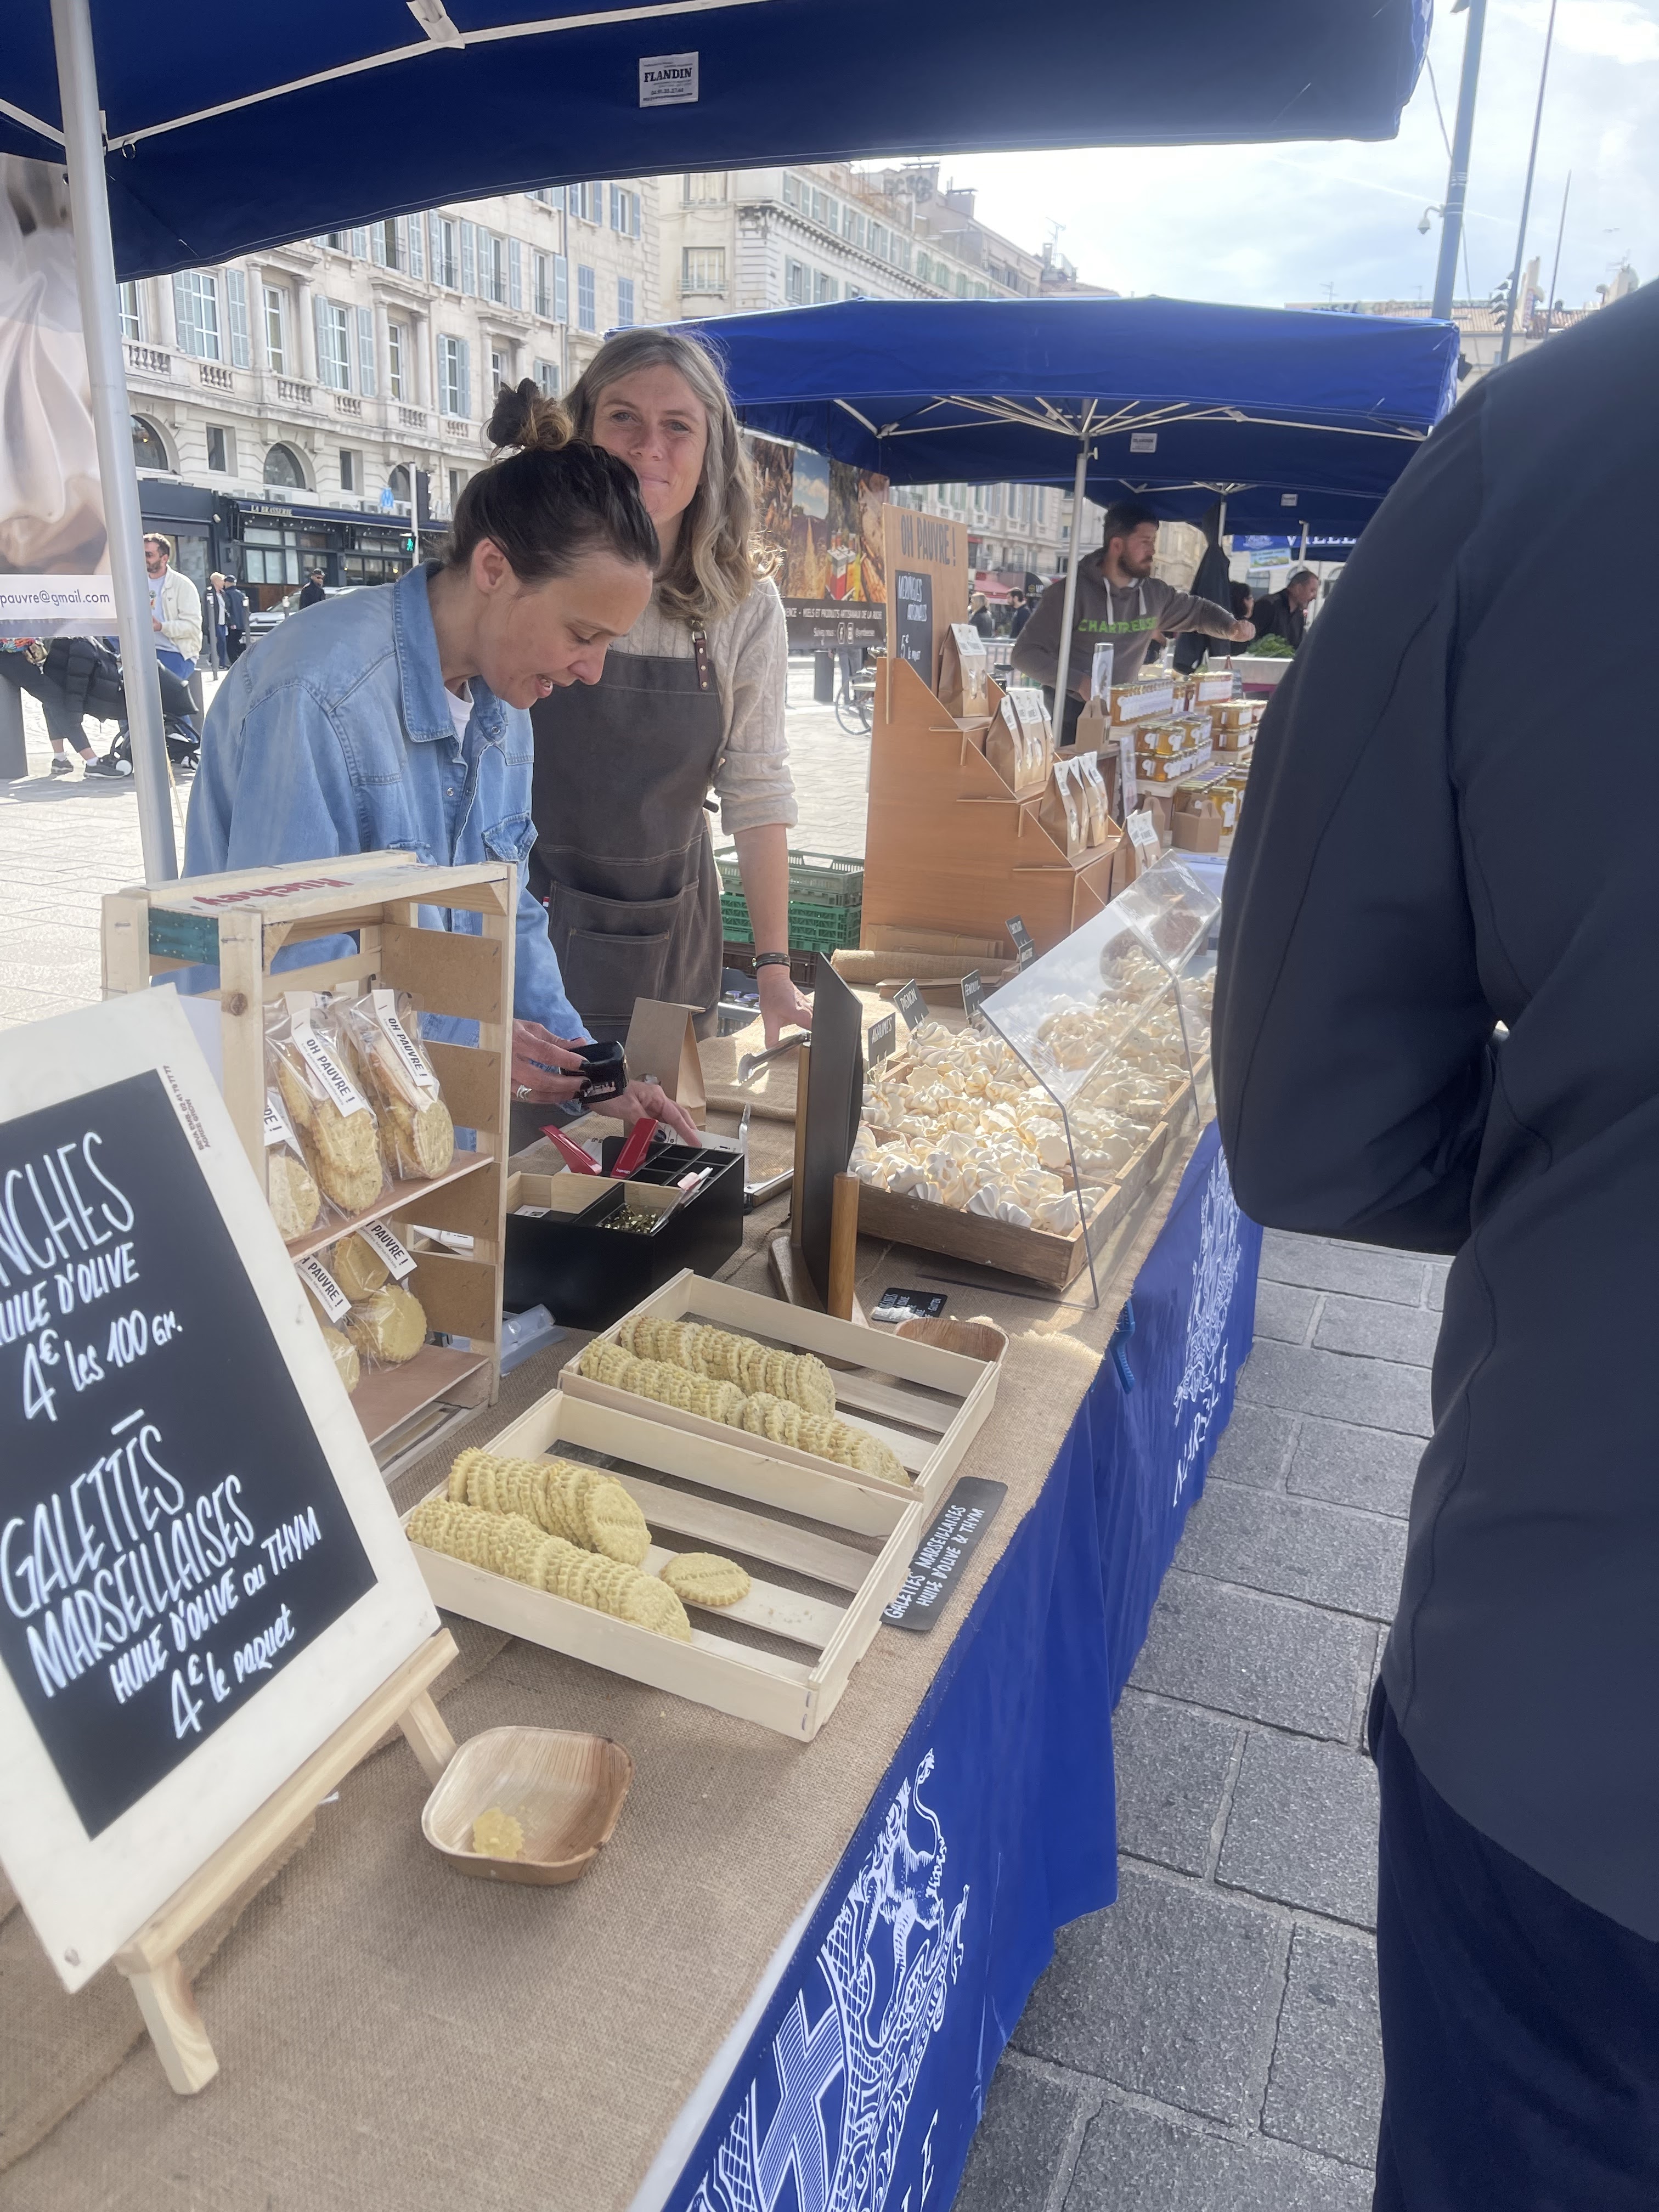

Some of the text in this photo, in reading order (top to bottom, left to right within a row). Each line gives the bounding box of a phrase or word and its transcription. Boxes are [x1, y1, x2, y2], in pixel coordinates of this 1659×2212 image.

[644, 67, 692, 83] FLANDIN
[901, 514, 913, 558] OH
[917, 517, 950, 565] PAUVRE
[0, 589, 110, 608] pauvre@gmail.com
[306, 1039, 321, 1054] OH
[317, 1056, 351, 1096] PAUVRE
[388, 1018, 401, 1030] OH
[397, 1034, 425, 1070] PAUVRE
[371, 1224, 405, 1260] PAUVRE
[0, 1242, 139, 1346] UILE D'OLIVE
[308, 1262, 340, 1301] PAUVRE
[64, 1340, 105, 1392] les
[106, 1310, 148, 1368] 100
[1, 1425, 185, 1617] GALETTES
[883, 1505, 966, 1618] GALETTES MARSEILLAISES
[916, 1508, 985, 1606] HUILE D'OLIVE & THYM
[26, 1474, 254, 1699] MARSEILLAISES
[109, 1623, 168, 1705] HUILE
[168, 1567, 240, 1653] D'OLIVE
[261, 1506, 322, 1576] THYM
[206, 1651, 231, 1703] le
